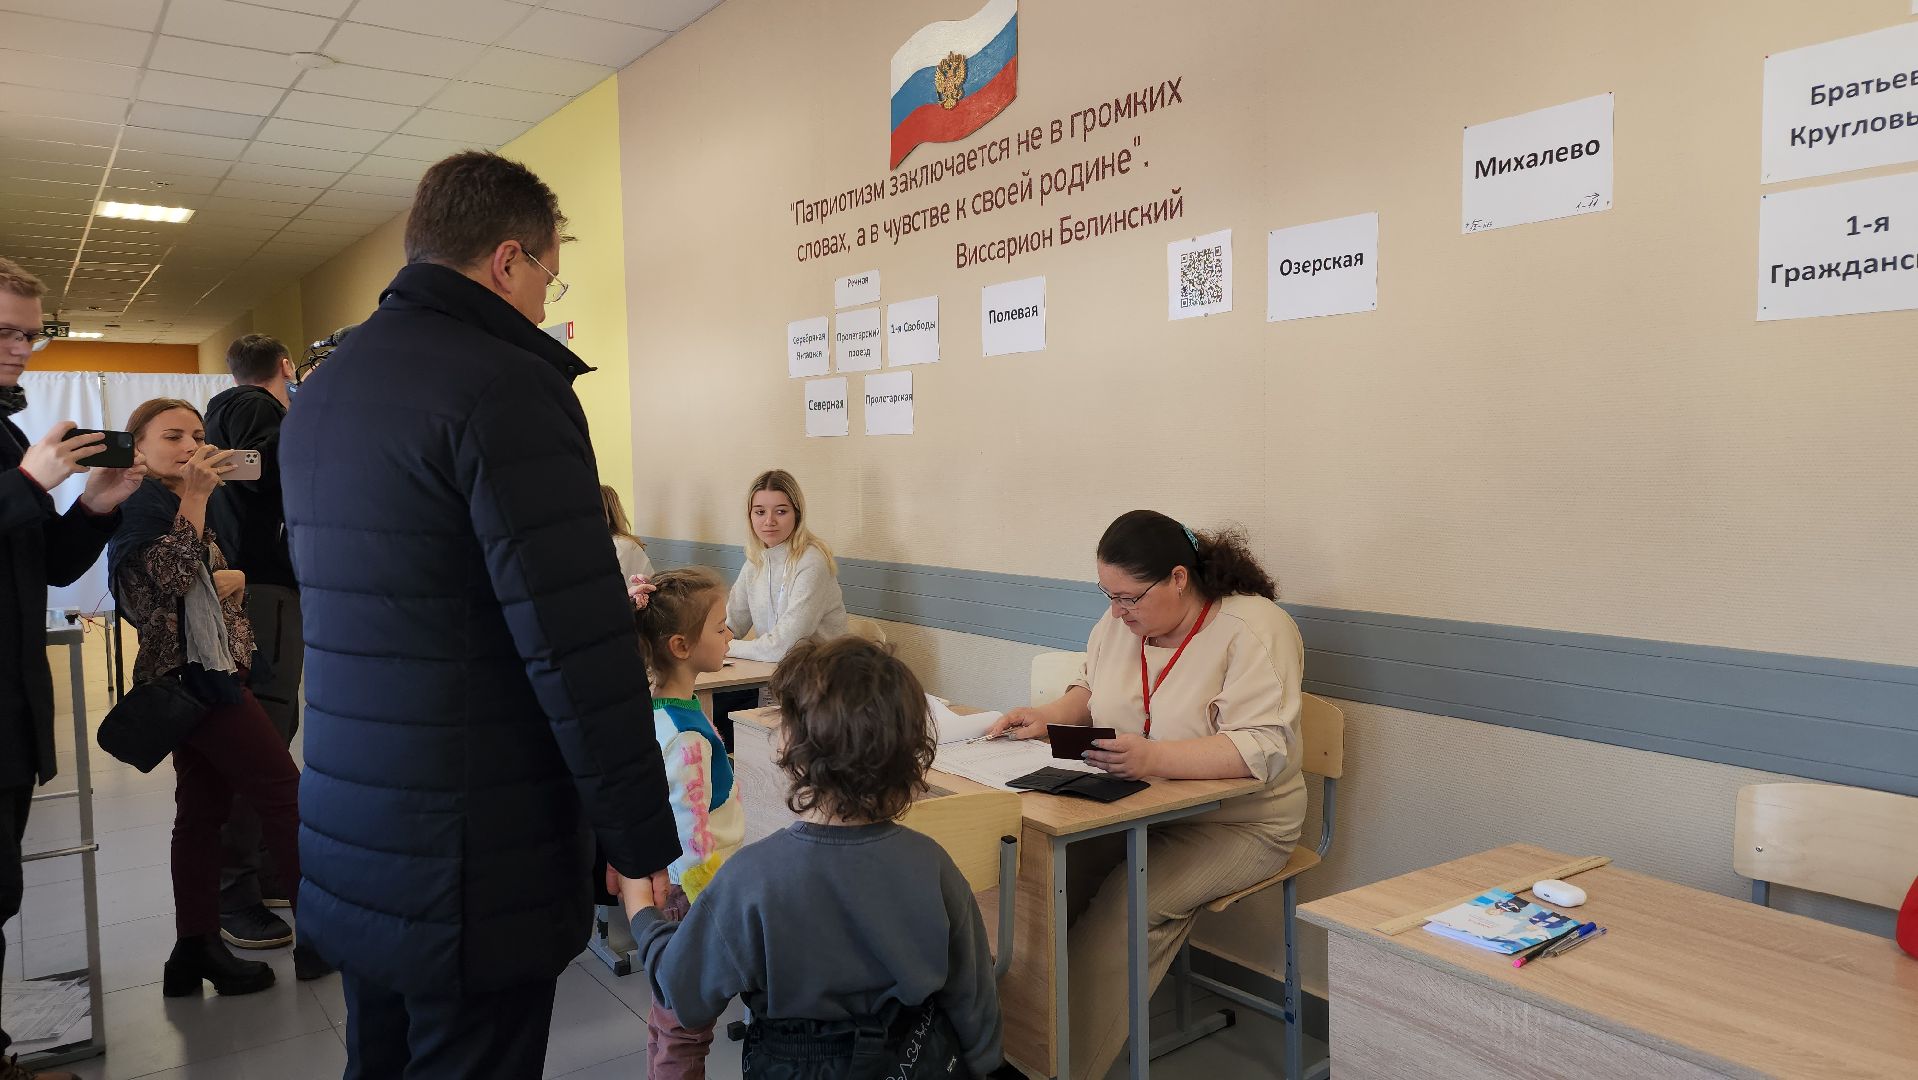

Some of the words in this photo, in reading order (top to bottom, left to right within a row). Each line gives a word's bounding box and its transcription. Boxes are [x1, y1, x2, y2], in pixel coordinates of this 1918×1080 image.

[790, 179, 885, 226] "Патриотизм
[889, 137, 1010, 197] заключается
[1016, 125, 1042, 155] не
[1049, 118, 1062, 145] в
[1069, 76, 1183, 142] громких
[1474, 137, 1601, 180] Михалево
[797, 231, 851, 262] словах,
[857, 226, 867, 247] а
[869, 222, 879, 243] в
[883, 203, 950, 244] чувстве
[956, 198, 967, 220] к
[971, 169, 1033, 216] своей
[1039, 135, 1150, 206] родине".
[956, 223, 1053, 269] Виссарион
[1059, 186, 1184, 245] Белинский
[1846, 214, 1890, 236] 1-я
[1279, 251, 1364, 276] Озерская
[1771, 251, 1918, 287] Гражданс
[903, 319, 936, 333] Свободы
[988, 303, 1039, 325] Полевая
[808, 398, 844, 413] Северная
[865, 392, 913, 407] Пролетарская
